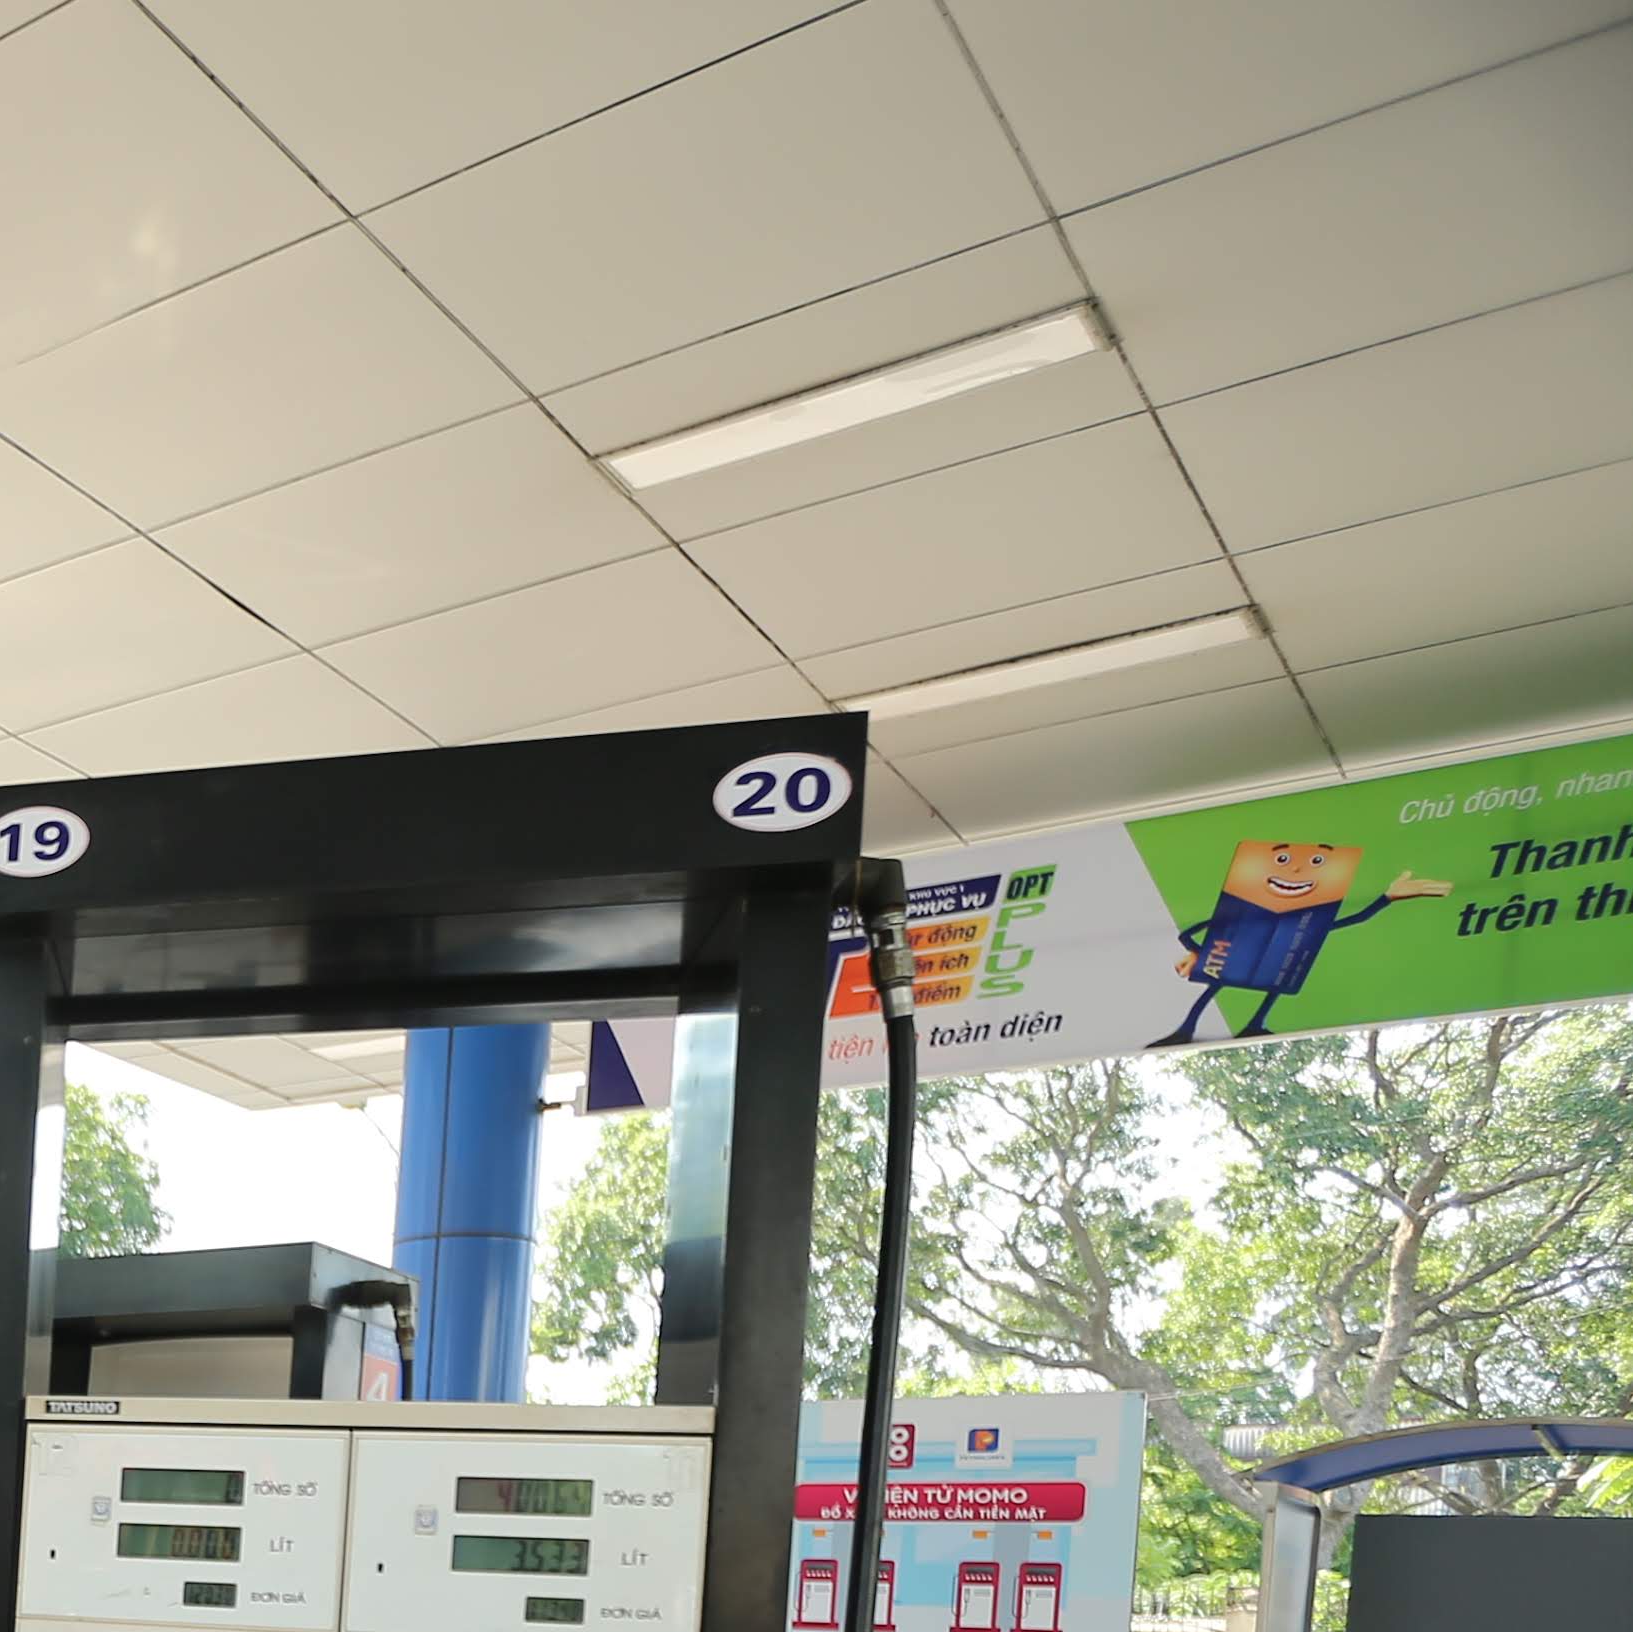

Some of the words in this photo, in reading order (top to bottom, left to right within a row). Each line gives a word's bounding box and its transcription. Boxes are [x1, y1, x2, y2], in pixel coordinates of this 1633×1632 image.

[731, 767, 831, 817] 20
[1399, 793, 1455, 824] Chủ
[1463, 784, 1543, 817] động,
[1006, 872, 1055, 901] OPT
[1456, 893, 1559, 937] trên
[928, 924, 978, 947] động
[1203, 940, 1231, 979] ATM
[929, 1015, 991, 1048] toàn
[1000, 1011, 1063, 1043] diện
[46, 1401, 119, 1414] TATSUNO
[885, 1486, 918, 1507] IỆN
[958, 1488, 1028, 1504] MOMO
[889, 1503, 939, 1518] KHÔNG
